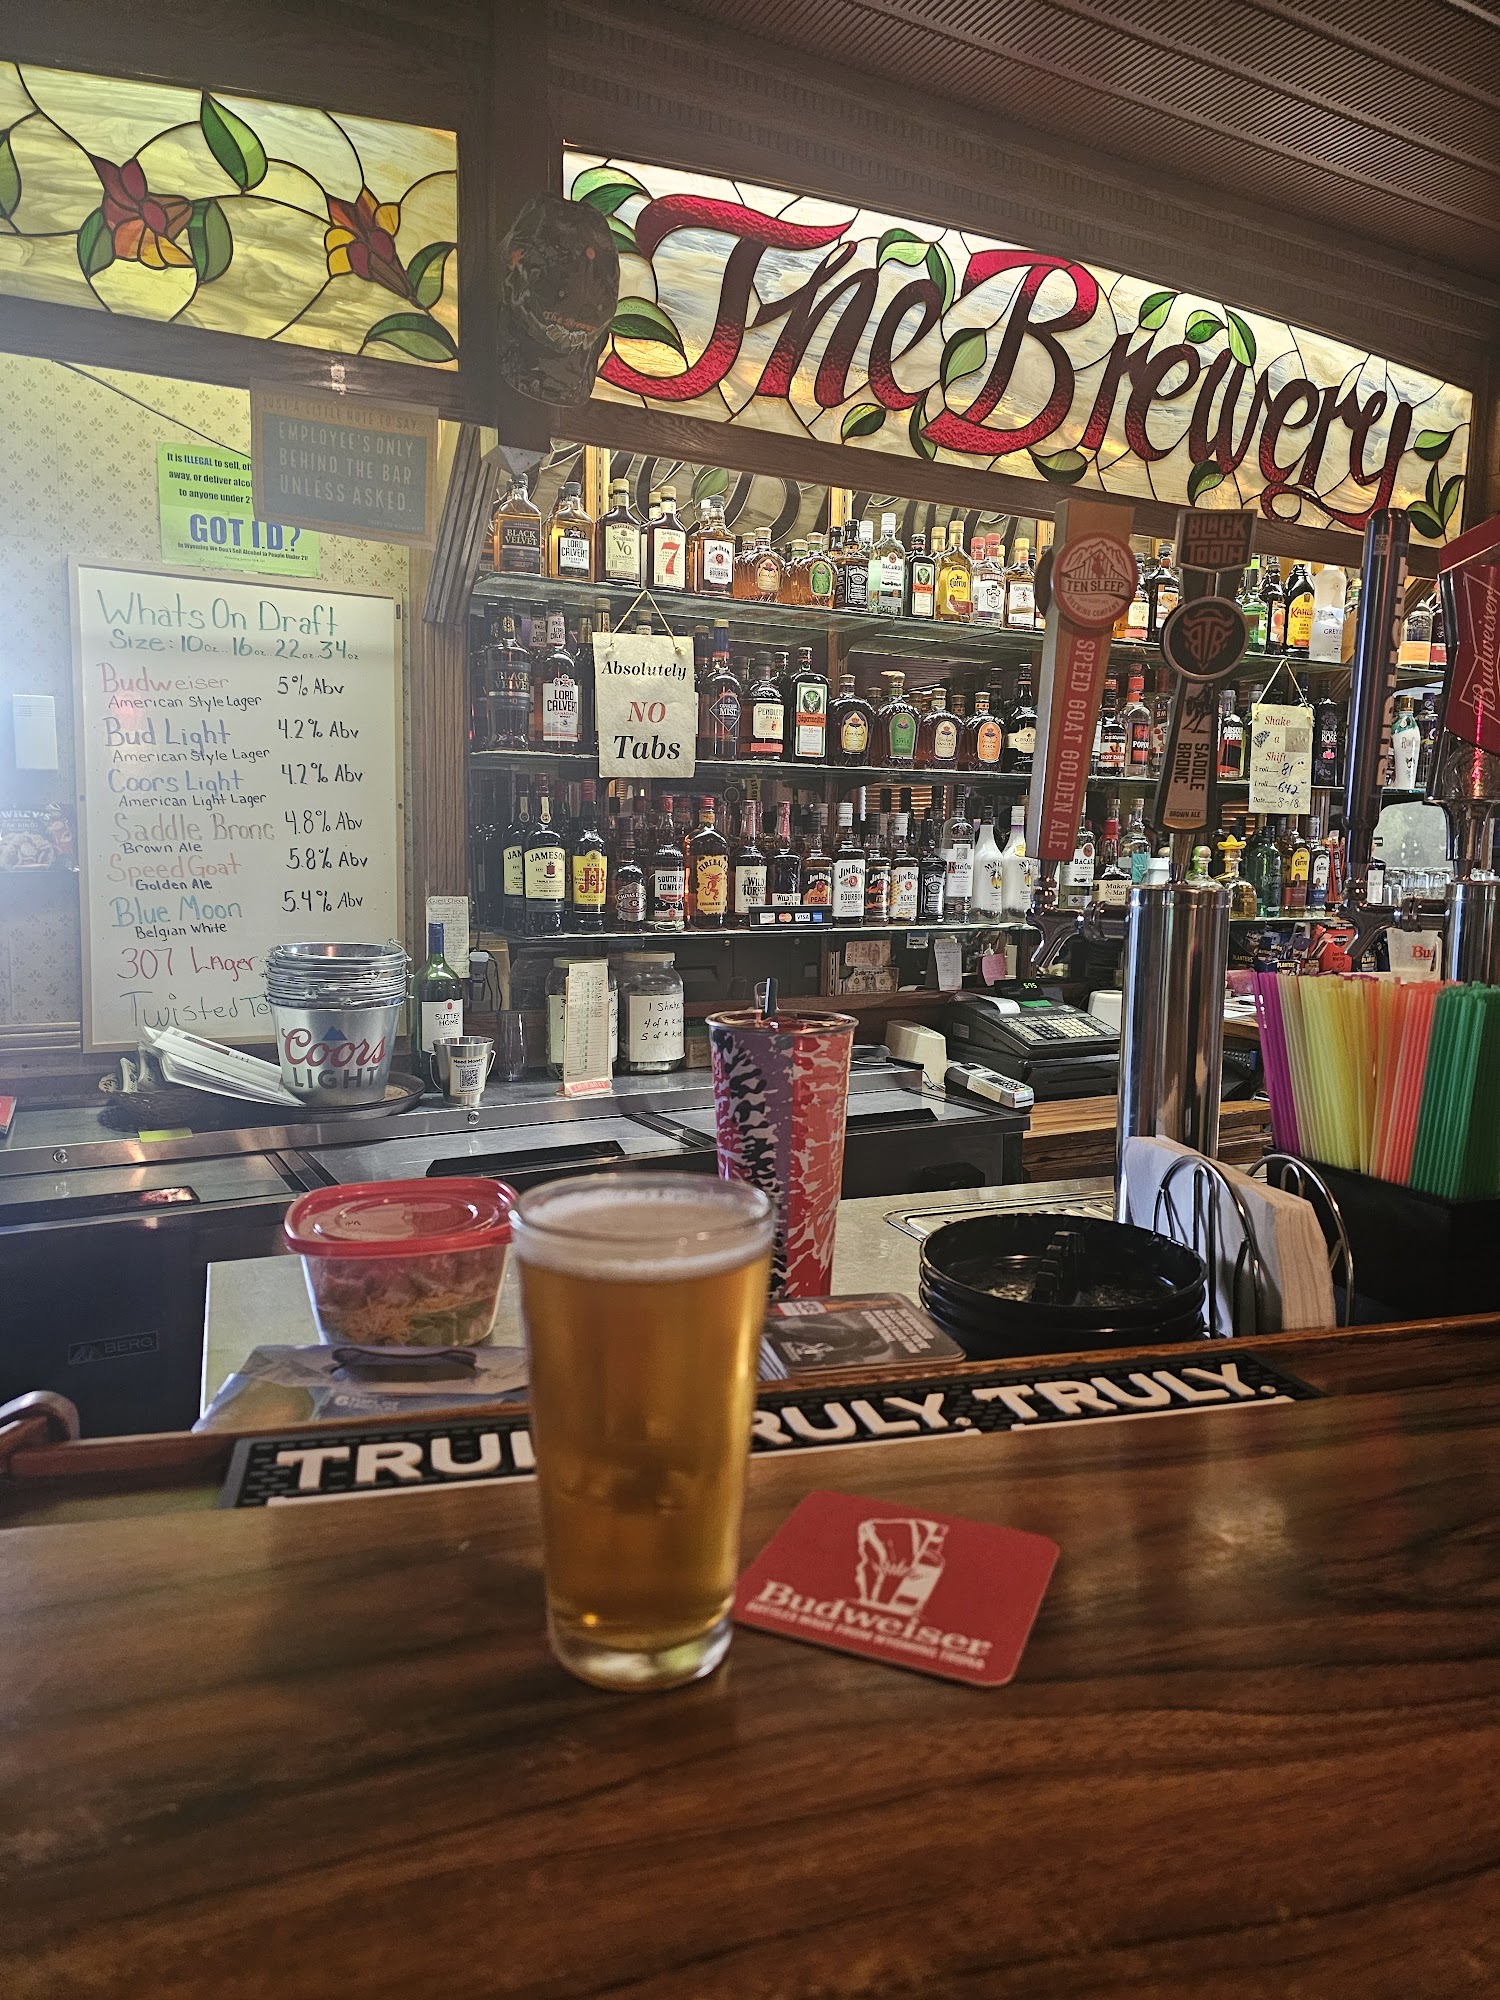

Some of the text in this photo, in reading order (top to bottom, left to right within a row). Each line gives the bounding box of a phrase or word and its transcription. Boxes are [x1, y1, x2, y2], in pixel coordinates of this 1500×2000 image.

[600, 192, 1413, 528] The Brewery
[279, 422, 414, 458] EMPLOYEE'S ONLY
[166, 452, 174, 462] It
[175, 454, 182, 462] is
[184, 454, 213, 467] ILLEGAL
[214, 458, 222, 468] to
[279, 447, 412, 486] BEHIND THE BAR
[168, 470, 192, 482] away,
[194, 474, 202, 482] or
[204, 474, 232, 486] deliver
[179, 488, 188, 497] to
[189, 490, 219, 502] anyone
[220, 492, 244, 504] under
[279, 474, 413, 513] UNLESS ASKED.
[190, 514, 244, 545] GOT
[506, 528, 536, 539] BLACK
[1188, 516, 1246, 539] BLACK
[504, 536, 538, 546] VELVET
[568, 540, 584, 548] LORD
[562, 547, 588, 560] CALVERT
[662, 542, 681, 575] 7
[1067, 580, 1124, 592] TEN SLEEP
[97, 590, 338, 636] Whats On Draft
[1092, 602, 1120, 617] COMPANY
[1471, 586, 1500, 717] Budweiser
[96, 662, 345, 696] Budweiser 5% Abv
[601, 660, 688, 682] Absolutely
[108, 695, 262, 712] American Style Lager
[554, 690, 574, 700] LORD
[627, 700, 666, 724] NO
[719, 708, 738, 716] MIST
[1264, 716, 1291, 726] Shake
[102, 716, 359, 750] Bud Light 4.2% Abv
[613, 735, 681, 760] Tabs
[1048, 638, 1096, 850] SPEED GOAT GOLDEN ALE
[113, 748, 271, 765] American Style Lager
[1174, 742, 1192, 784] BRONC
[1266, 752, 1287, 764] Shift
[1190, 742, 1210, 792] SADDLE
[107, 768, 180, 794] Coors
[185, 769, 245, 795] Light
[334, 768, 364, 784] Abv
[1278, 782, 1300, 795] 642
[118, 792, 267, 810] American Light Lager
[1168, 810, 1201, 818] BROWN ALE
[112, 810, 363, 842] Saddle Bronc 4.8% Abv
[120, 842, 203, 854] Brown Ale
[106, 847, 368, 886] Speed Goat 5.8% Abv
[838, 866, 851, 879] JIM
[135, 878, 213, 891] Golden Ale
[578, 868, 606, 894] J&B
[748, 877, 764, 886] WILD
[897, 874, 908, 884] JIM
[110, 890, 364, 928] Blue Moon 5.4% Abv
[134, 922, 228, 941] Belgian White
[117, 948, 173, 980] 307
[1232, 954, 1254, 963] PLANTERS
[120, 990, 272, 1028] Twisted Te
[434, 1012, 460, 1020] SUTTER
[640, 1032, 648, 1041] 5
[280, 1026, 386, 1068] Coors
[292, 1066, 380, 1090] LIGHT
[105, 1338, 154, 1355] BERG
[748, 1392, 972, 1446] RULY.
[972, 1362, 1277, 1418] TRULY.
[755, 1580, 994, 1656] Budweiser
